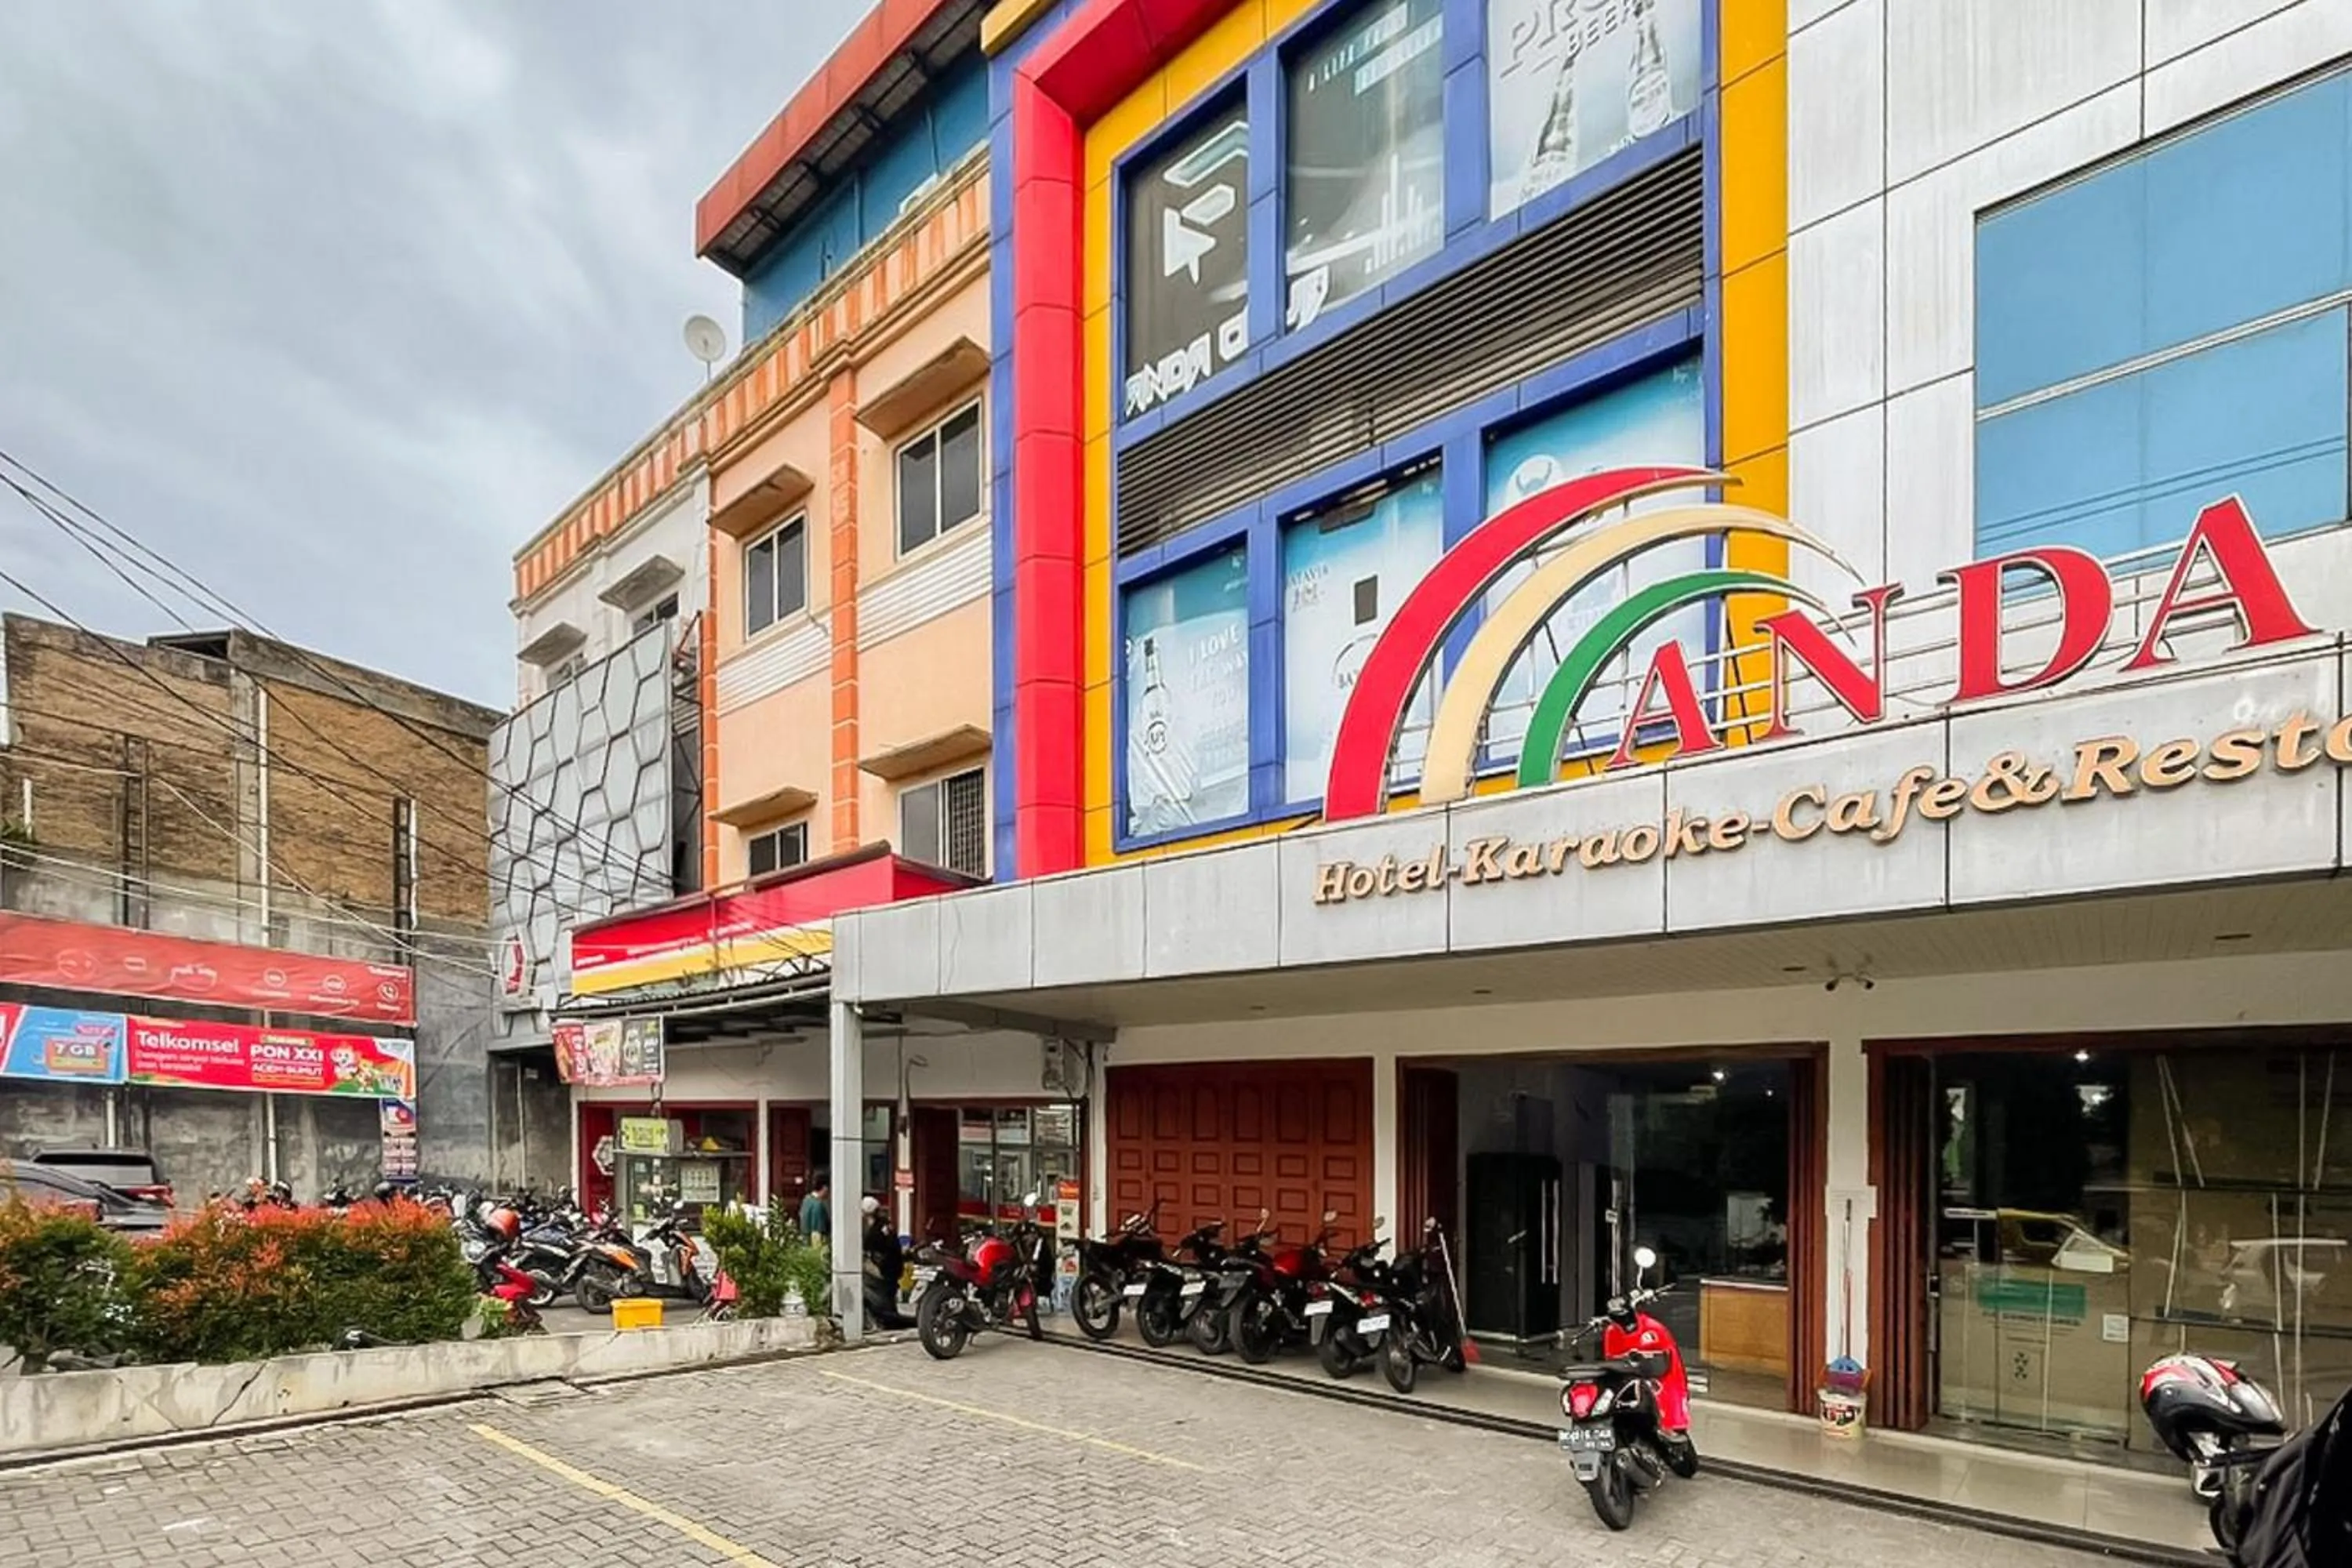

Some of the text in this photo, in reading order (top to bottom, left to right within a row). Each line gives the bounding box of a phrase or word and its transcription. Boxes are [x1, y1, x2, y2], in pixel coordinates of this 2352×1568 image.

[1200, 622, 1240, 659] LOVE
[1604, 492, 2323, 772] ANDA
[54, 1042, 96, 1056] 7 GB
[135, 1030, 239, 1054] Telkomsel
[250, 1044, 290, 1059] PON
[293, 1047, 324, 1062] XXI
